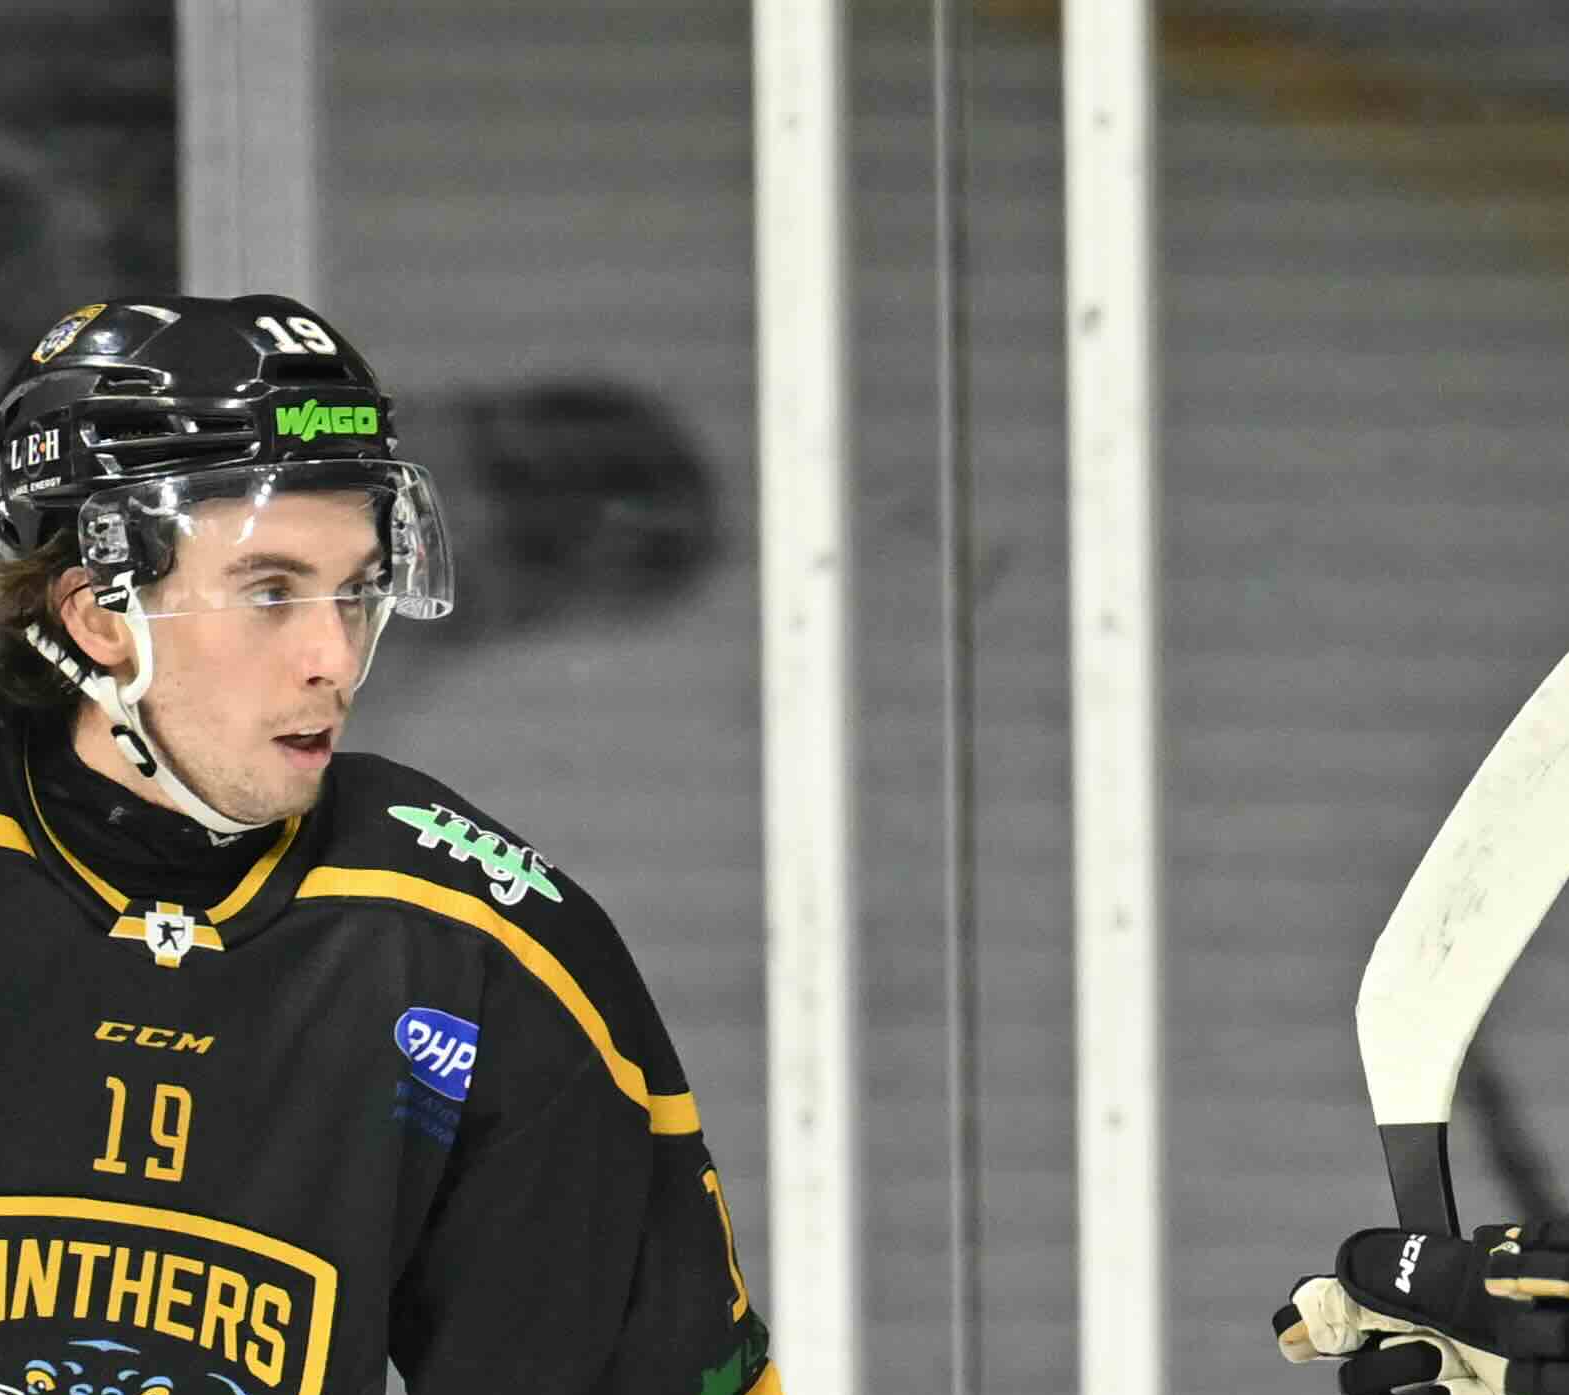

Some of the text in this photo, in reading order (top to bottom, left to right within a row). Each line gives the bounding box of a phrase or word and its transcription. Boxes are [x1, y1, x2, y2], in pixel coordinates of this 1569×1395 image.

[255, 315, 338, 355] 19
[275, 401, 379, 442] WAGO
[93, 1020, 216, 1056] CCM
[92, 1075, 194, 1183] 19
